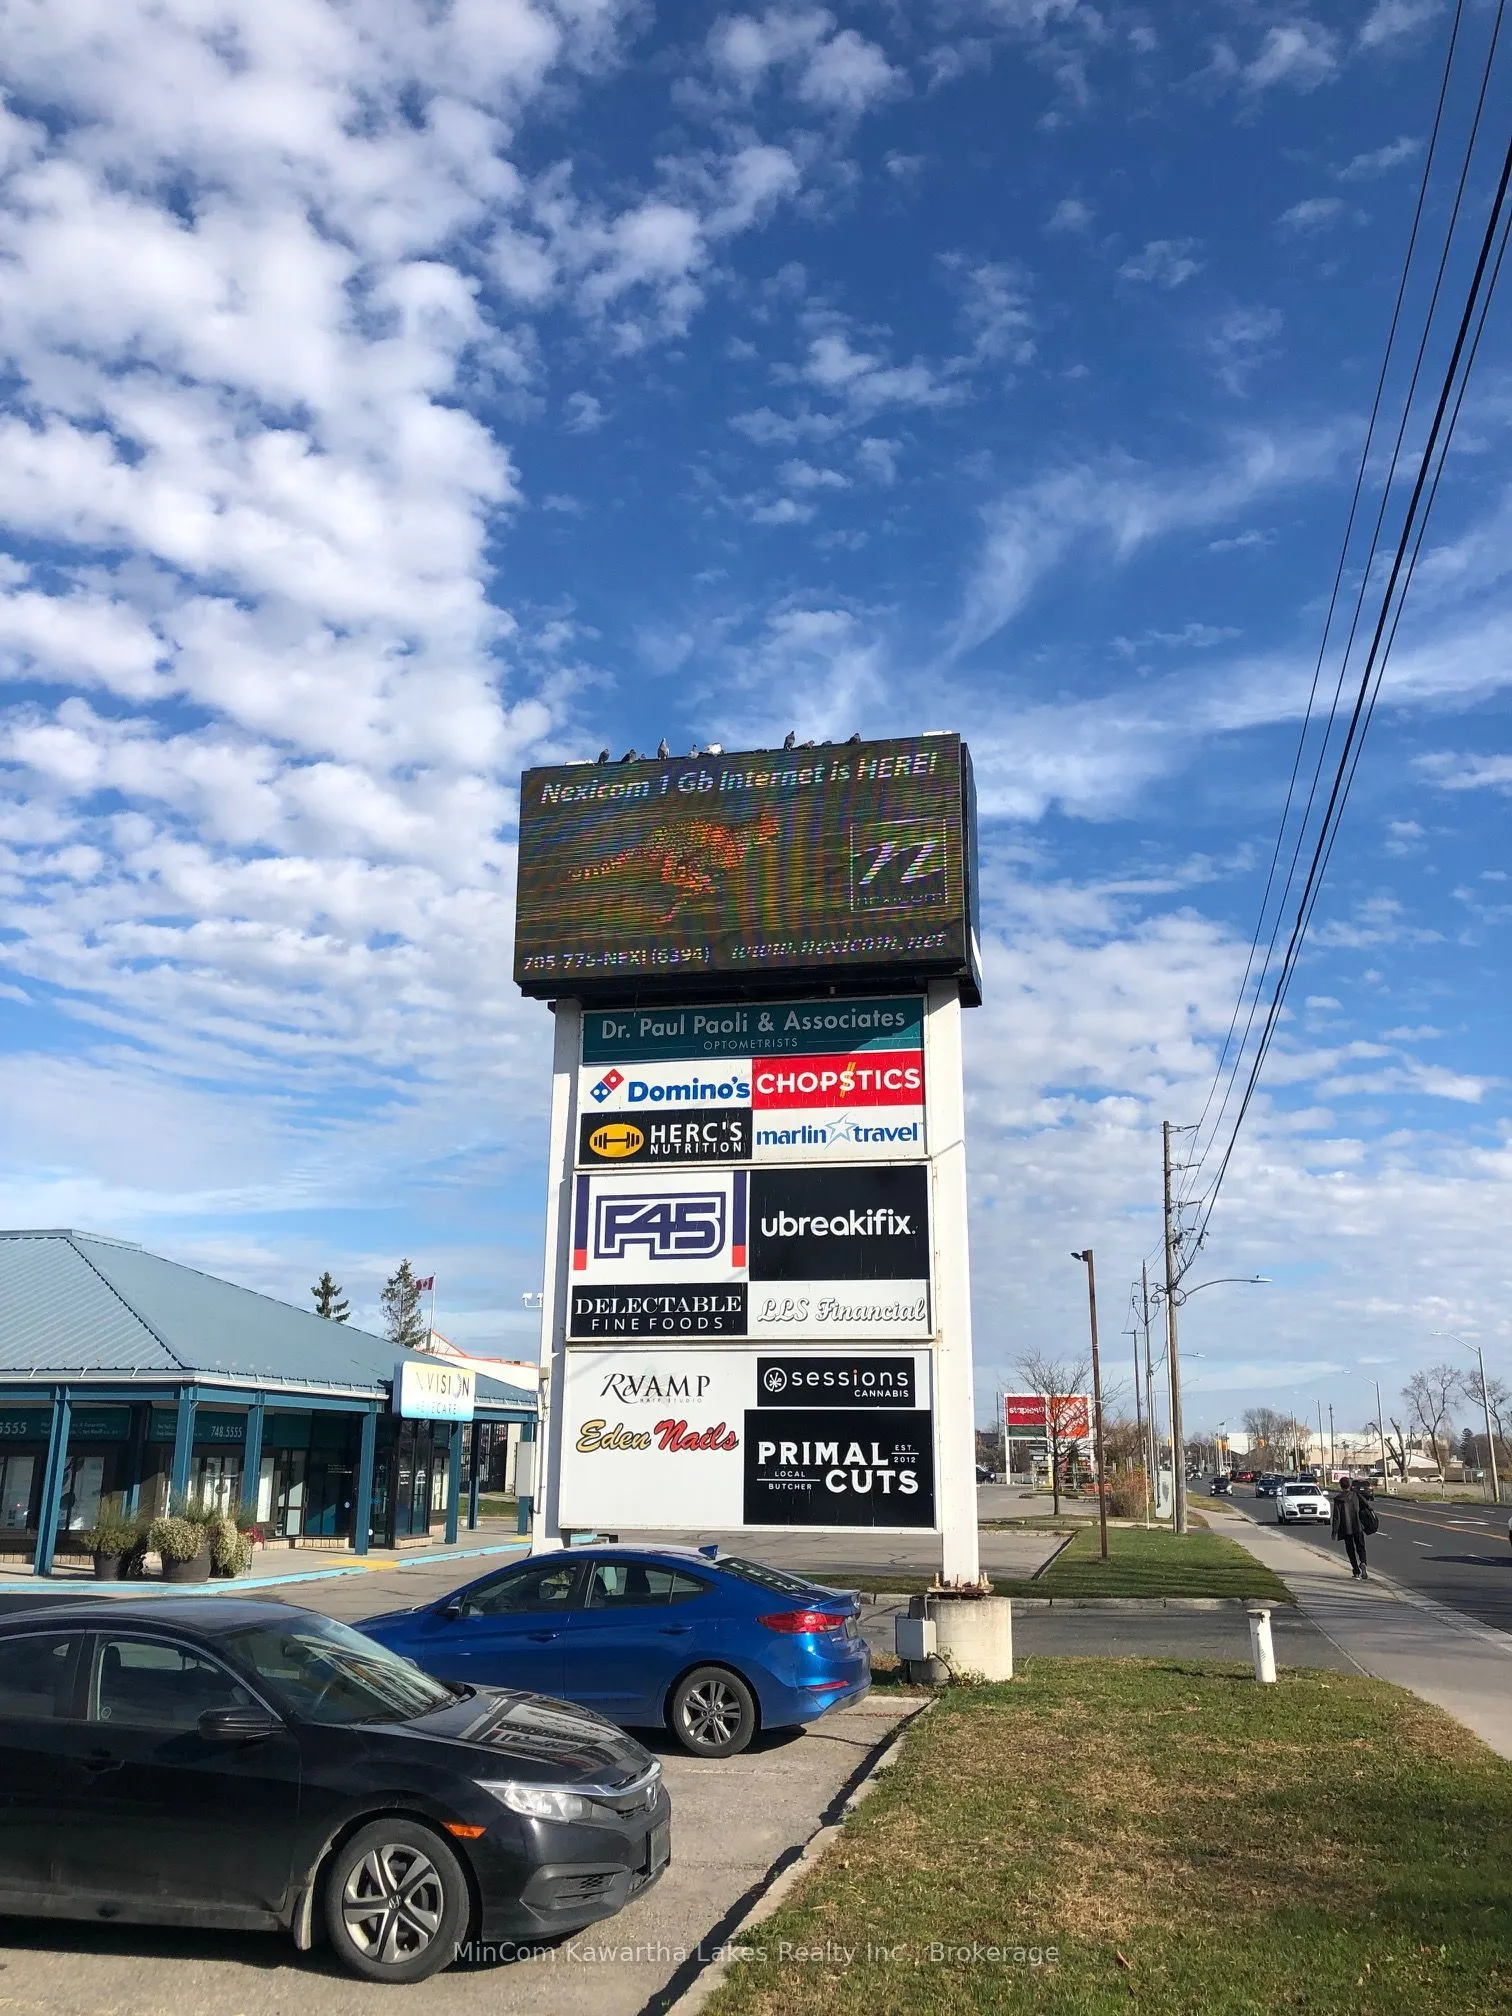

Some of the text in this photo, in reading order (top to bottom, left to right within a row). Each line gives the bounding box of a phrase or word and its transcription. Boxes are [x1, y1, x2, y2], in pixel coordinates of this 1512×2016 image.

[540, 779, 650, 804] Nexicom
[677, 770, 713, 794] Gb
[719, 763, 825, 791] Internet
[830, 760, 850, 782] is
[857, 752, 938, 781] HERE!
[602, 1008, 906, 1039] Dr. Paul Paoli & Associates
[703, 1037, 798, 1051] OPTOMETRISTS
[628, 1076, 750, 1103] Domino's
[650, 1121, 743, 1144] HERC'S
[756, 1122, 918, 1146] marlin travel
[650, 1141, 743, 1155] NUTRITION
[594, 1192, 726, 1260] F45
[575, 1295, 742, 1316] DELECTABLE
[815, 1296, 926, 1323] Financial
[591, 1317, 724, 1331] FINE FOODS
[792, 1369, 909, 1387] sessions
[854, 1390, 909, 1398] CANNABIS
[576, 1419, 740, 1453] Eden Nails
[757, 1441, 889, 1466] PRIMAL
[894, 1444, 915, 1452] EST.
[774, 1470, 806, 1478] LOCAL
[825, 1470, 919, 1494] CUTS
[768, 1483, 812, 1491] BUTCHER
